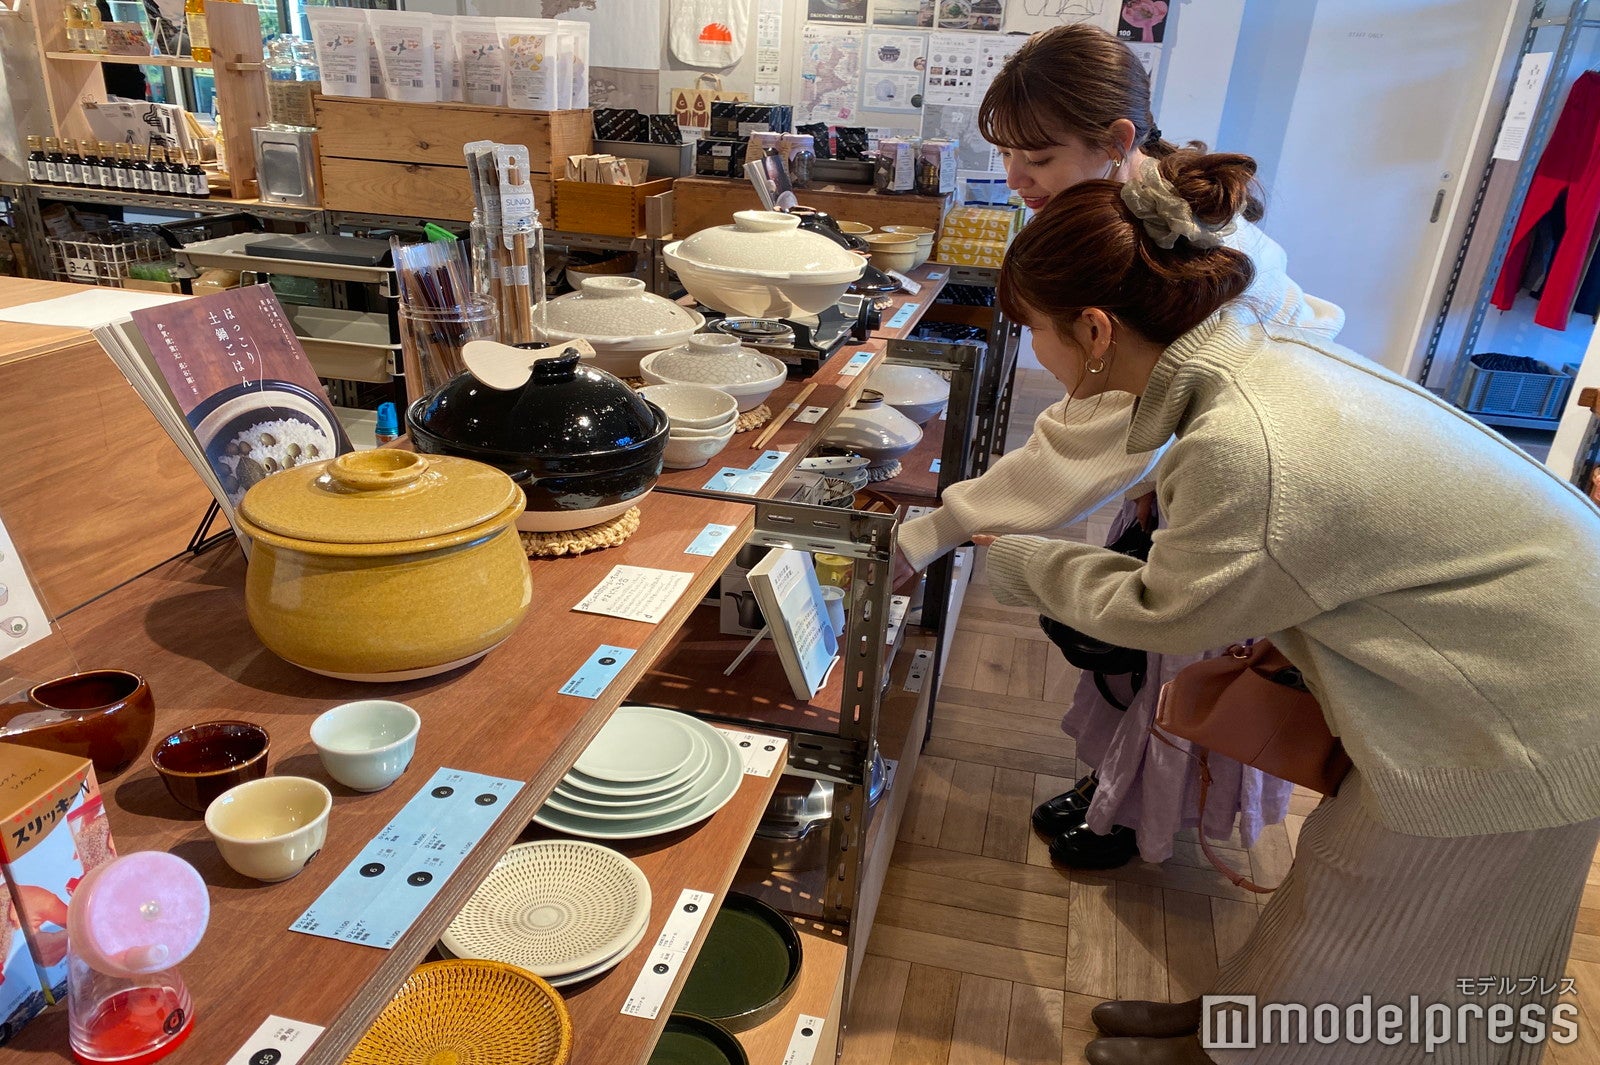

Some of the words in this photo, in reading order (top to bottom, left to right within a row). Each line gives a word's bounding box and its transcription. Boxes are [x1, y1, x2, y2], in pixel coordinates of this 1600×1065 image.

[506, 198, 531, 207] SUNAO
[69, 262, 92, 274] 3-4
[222, 307, 254, 365] ほっこり
[208, 311, 253, 388] 土鍋ごはん
[259, 1054, 274, 1065] 55
